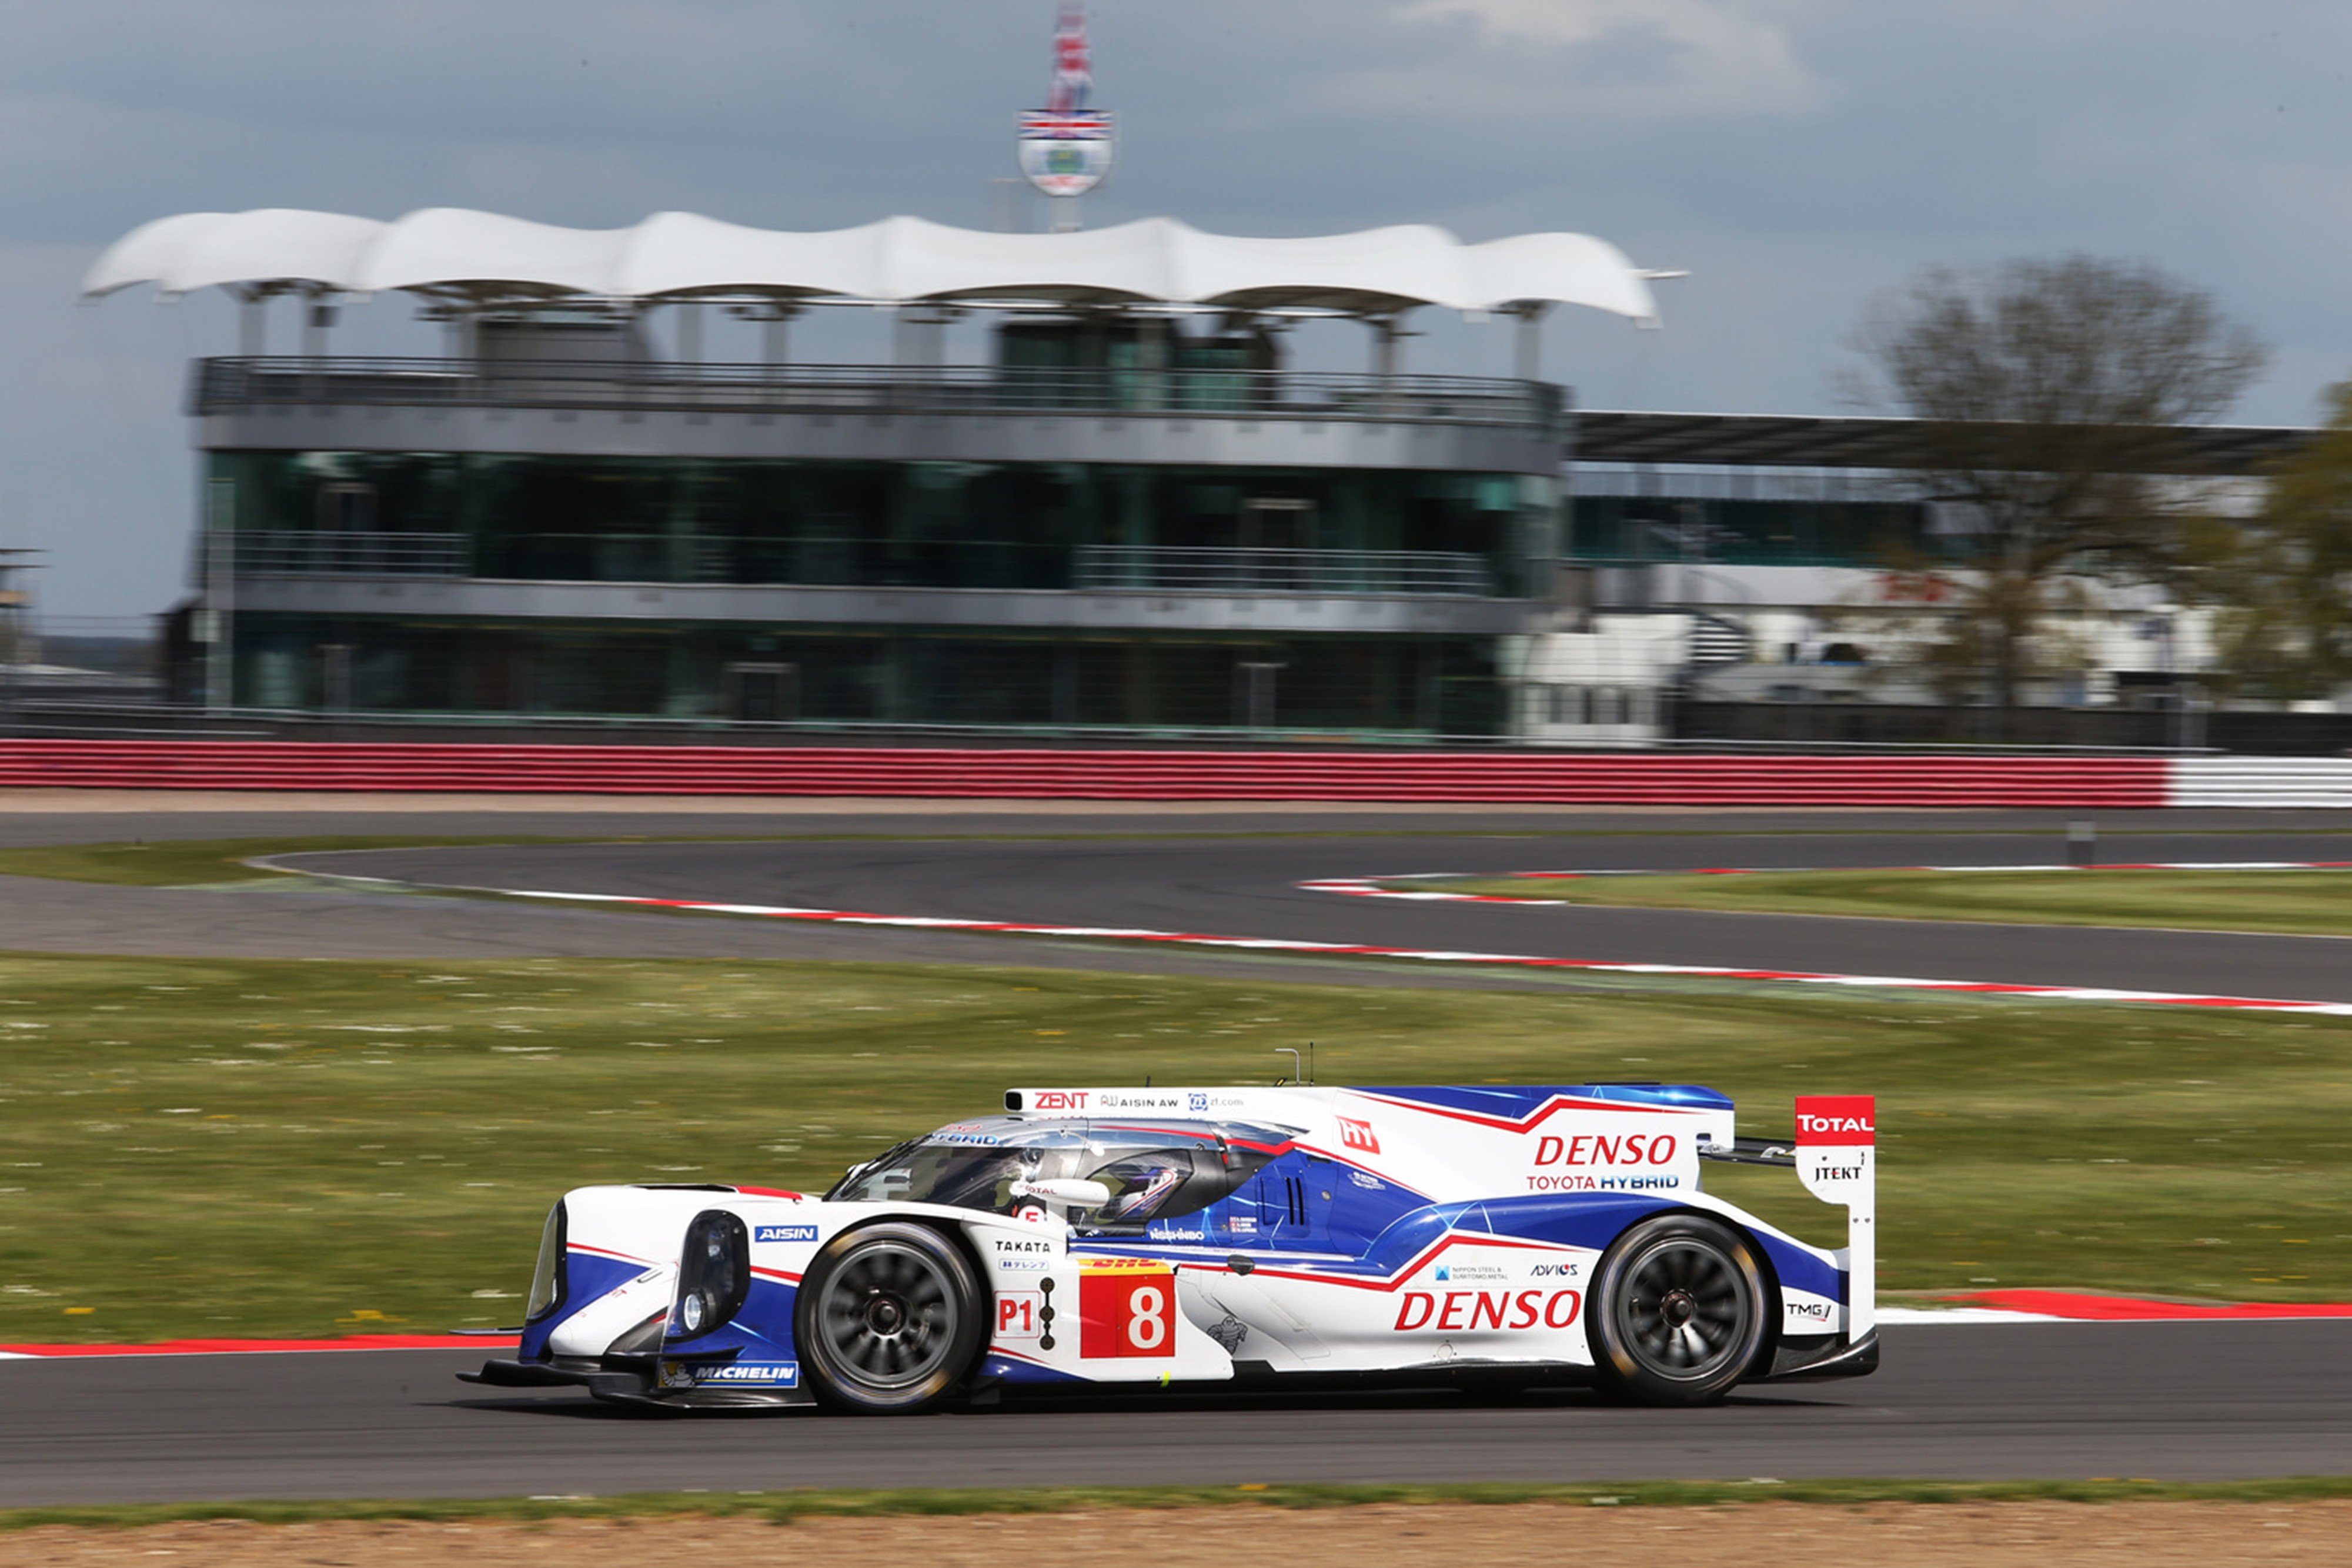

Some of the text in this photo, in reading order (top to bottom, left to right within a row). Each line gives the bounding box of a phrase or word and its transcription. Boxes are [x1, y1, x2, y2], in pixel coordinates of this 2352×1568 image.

[1035, 1092, 1088, 1109] ZENT
[1120, 1099, 1155, 1108] AISIN
[1160, 1099, 1178, 1108] AW
[1797, 1114, 1875, 1132] TOTAL
[1534, 1134, 1676, 1166] DENSO
[1815, 1166, 1862, 1182] JTEKT
[1527, 1175, 1679, 1190] TOYOTA HYBRID
[759, 1228, 814, 1240] AISIN
[995, 1241, 1051, 1252] TAKATA
[1000, 1299, 1031, 1331] P1
[1128, 1286, 1165, 1349] 8
[1394, 1289, 1581, 1330] DENSO
[695, 1366, 794, 1379] MICHELIN
